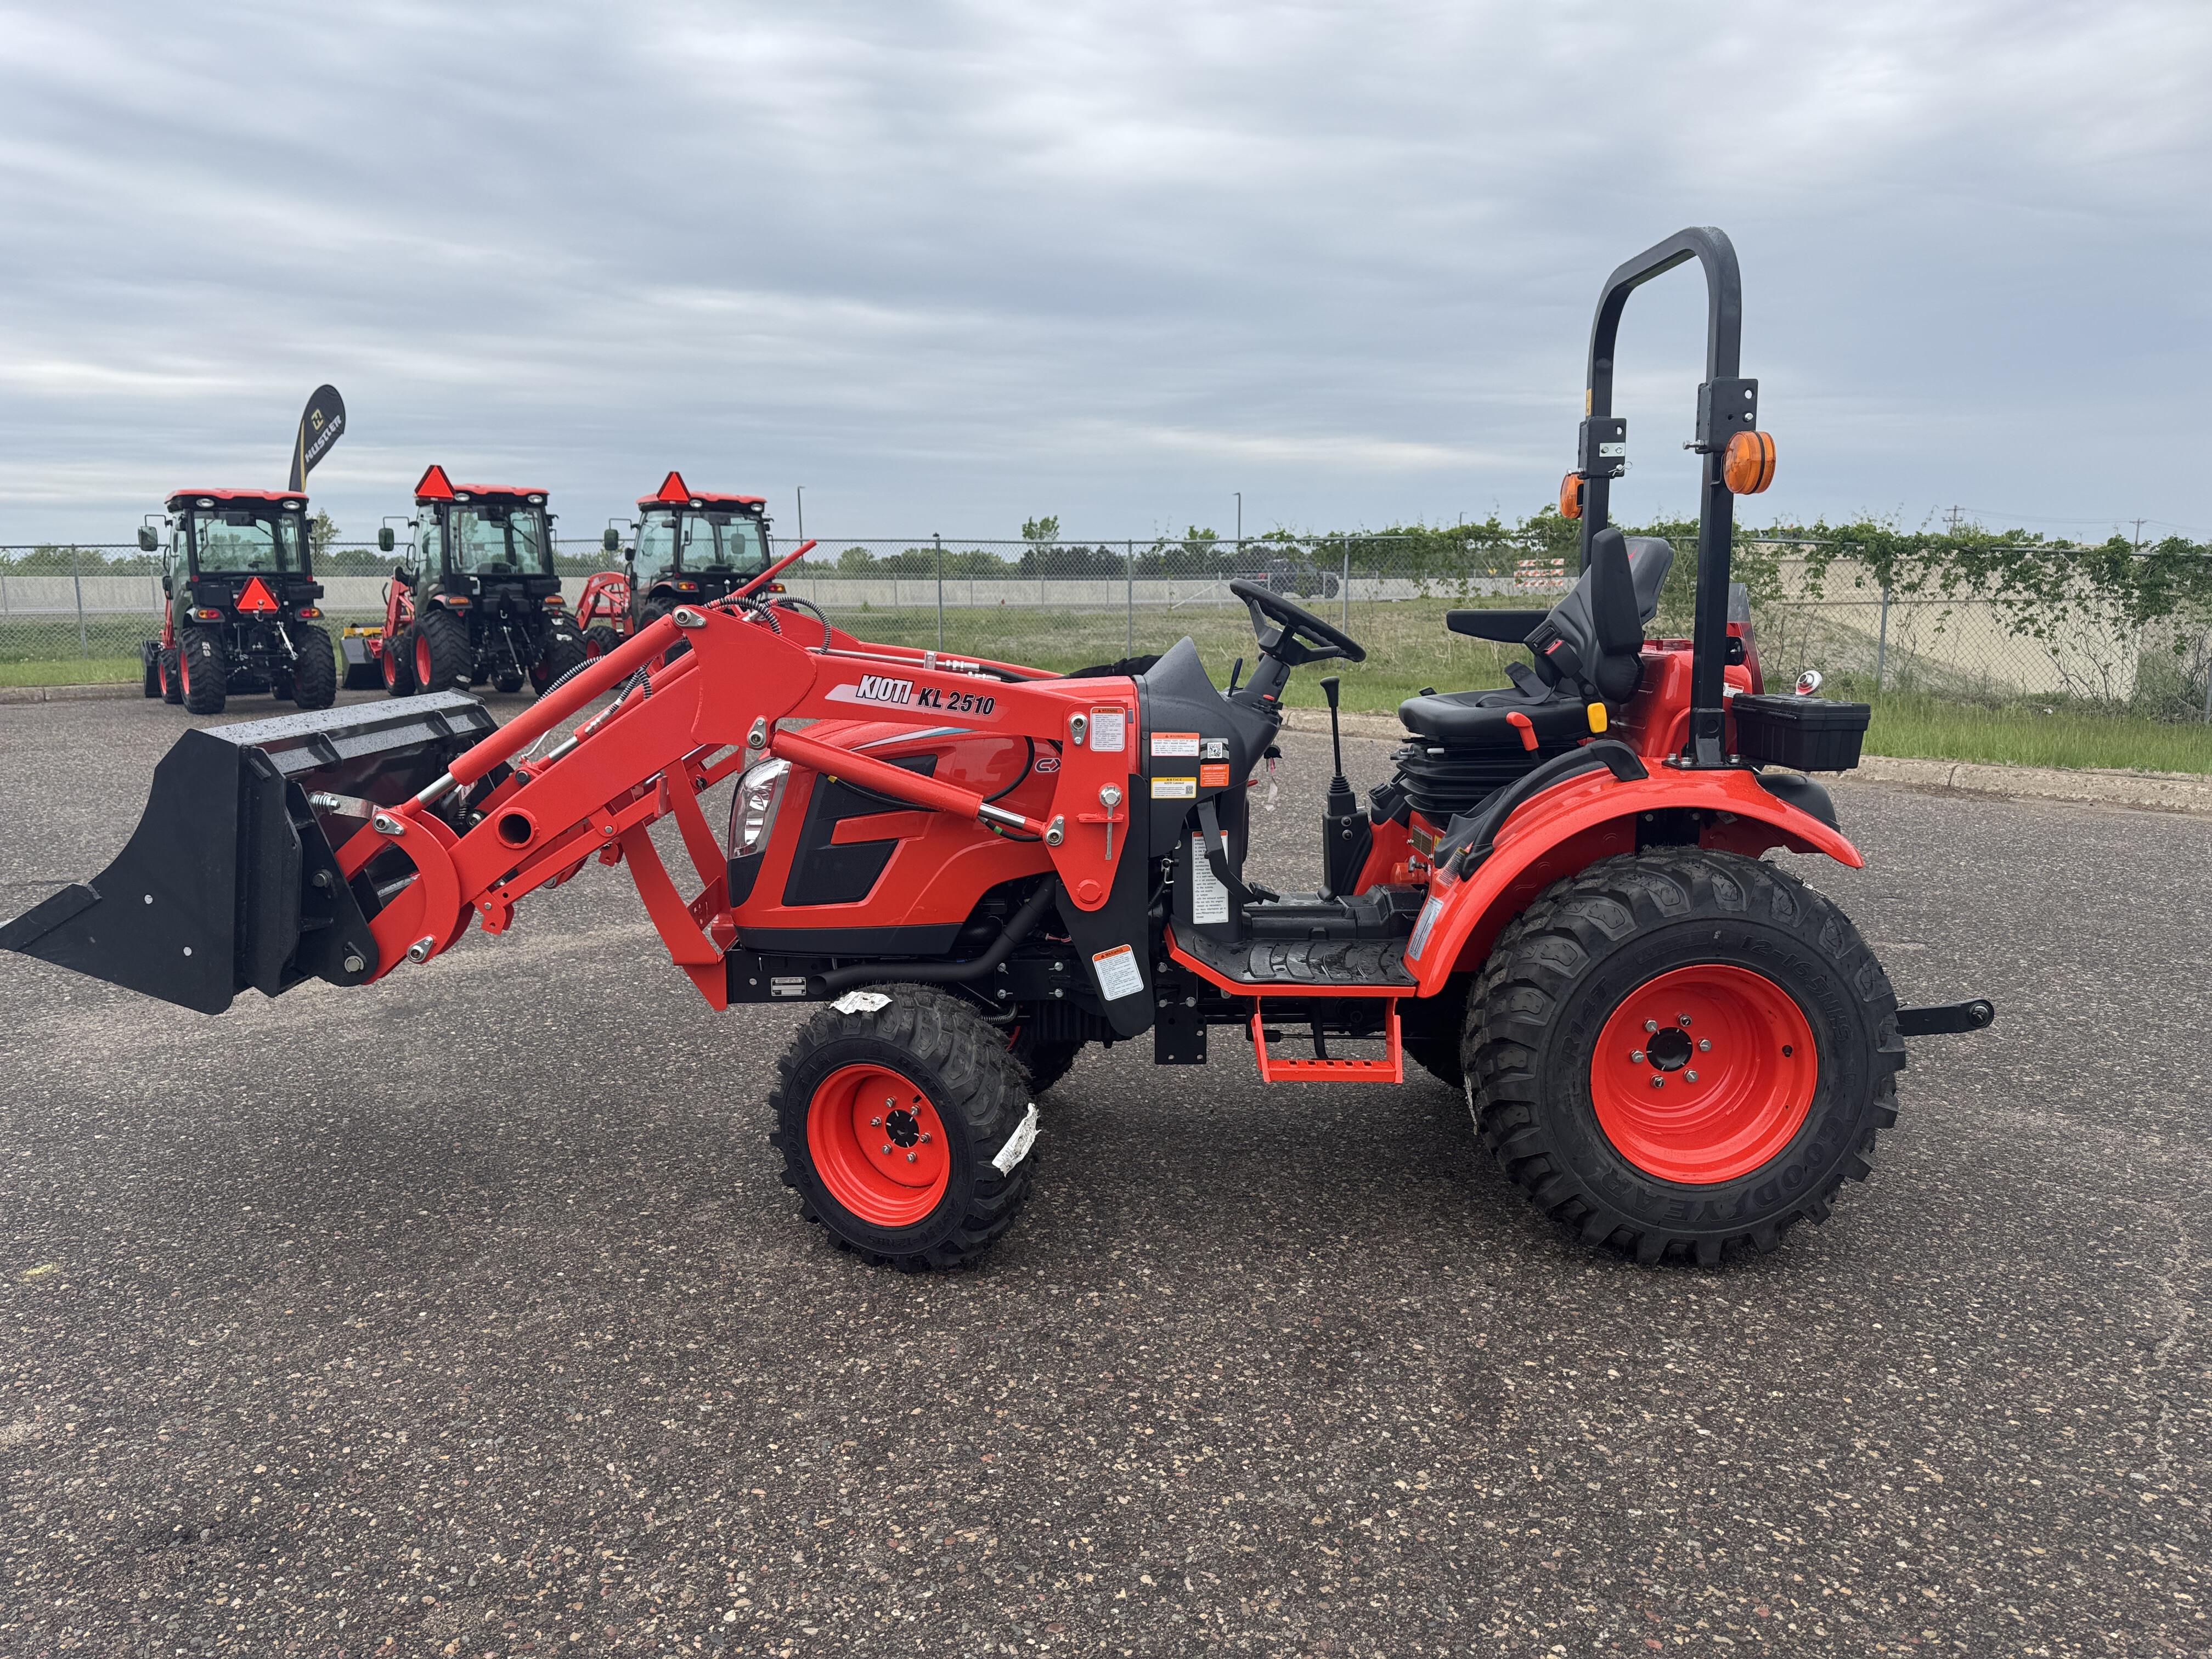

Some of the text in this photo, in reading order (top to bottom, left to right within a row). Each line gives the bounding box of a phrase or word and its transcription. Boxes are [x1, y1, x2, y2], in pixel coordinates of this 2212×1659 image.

[304, 415, 342, 463] HUSTLER
[856, 674, 996, 716] KIOTI KL 2510
[1559, 975, 1609, 1066] R14T
[1601, 1115, 1844, 1223] GOODYEAR
